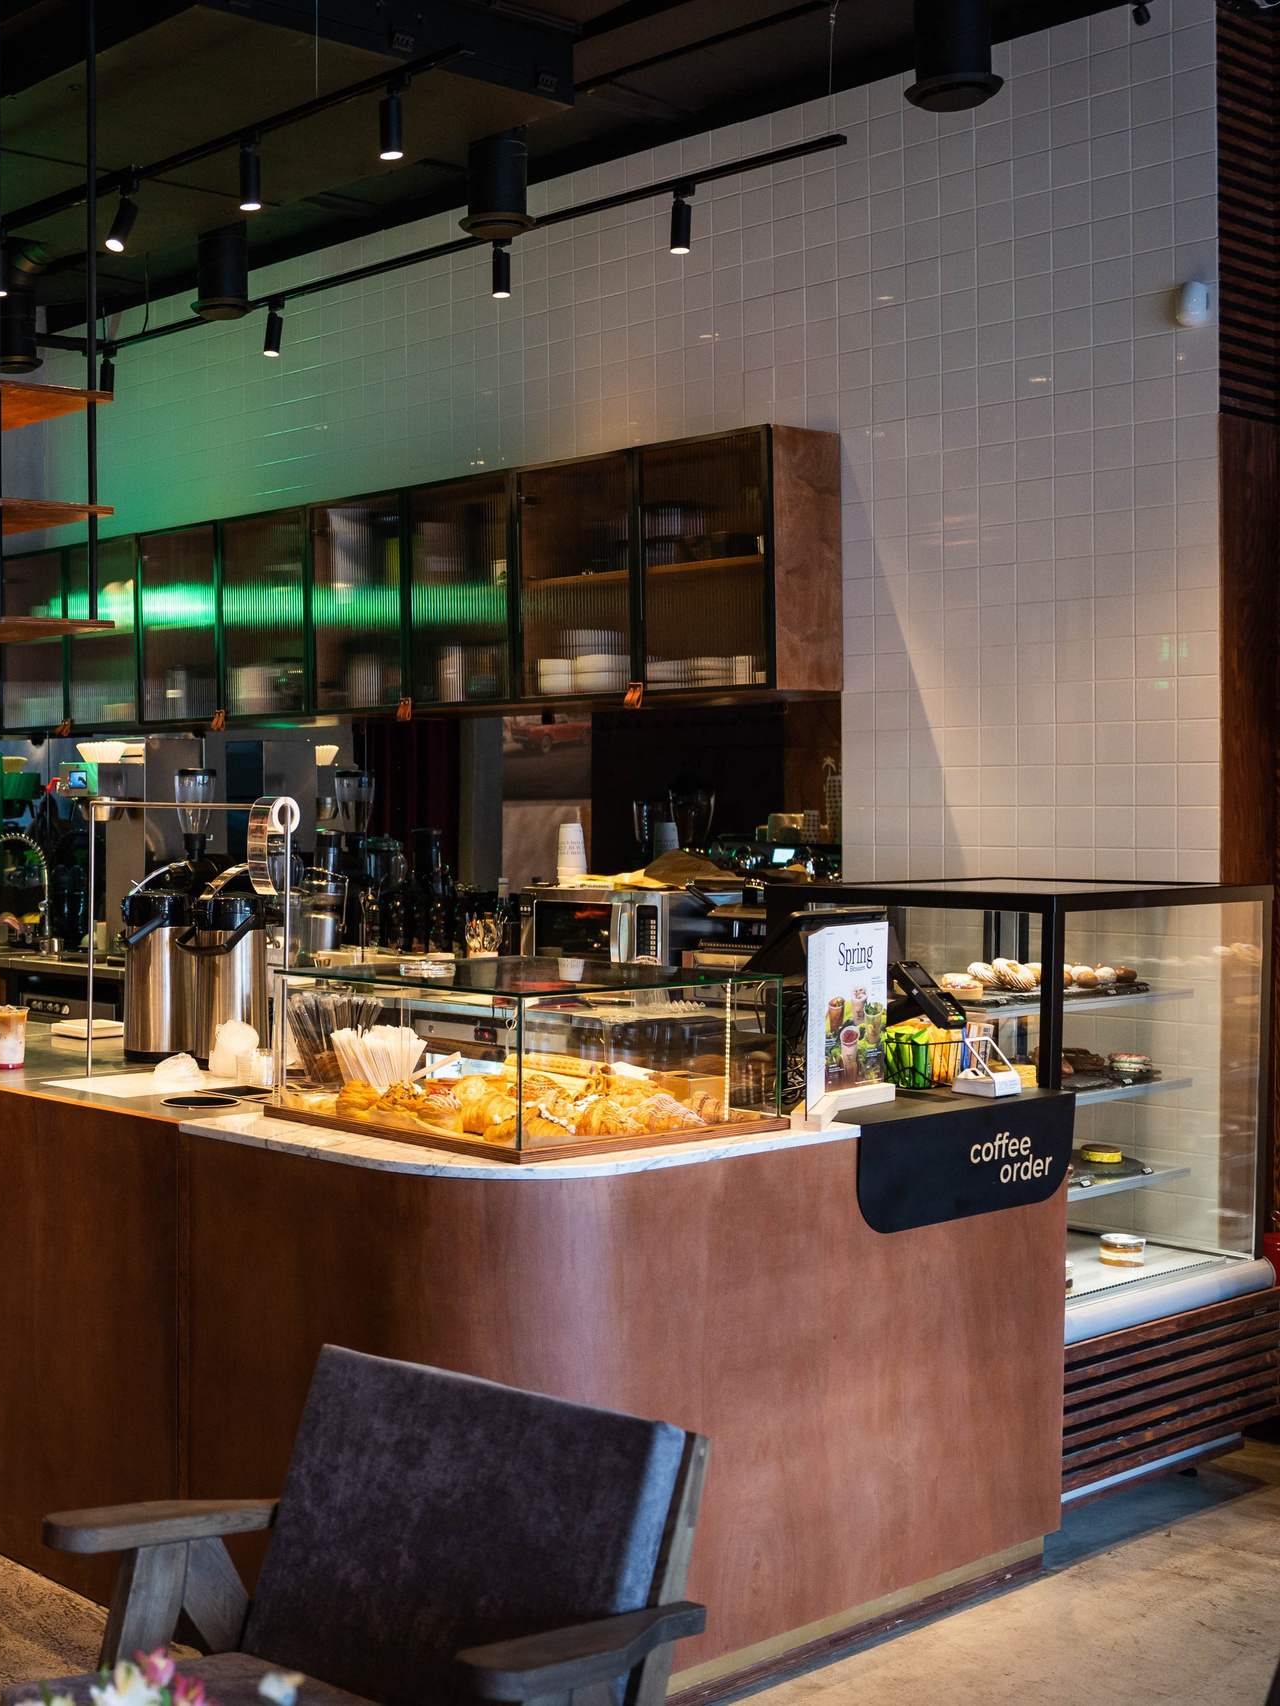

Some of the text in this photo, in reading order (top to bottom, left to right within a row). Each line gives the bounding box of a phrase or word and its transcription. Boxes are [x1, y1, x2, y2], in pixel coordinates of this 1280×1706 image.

[838, 942, 873, 972] Spring
[970, 1131, 1031, 1164] coffee
[999, 1153, 1053, 1184] order
